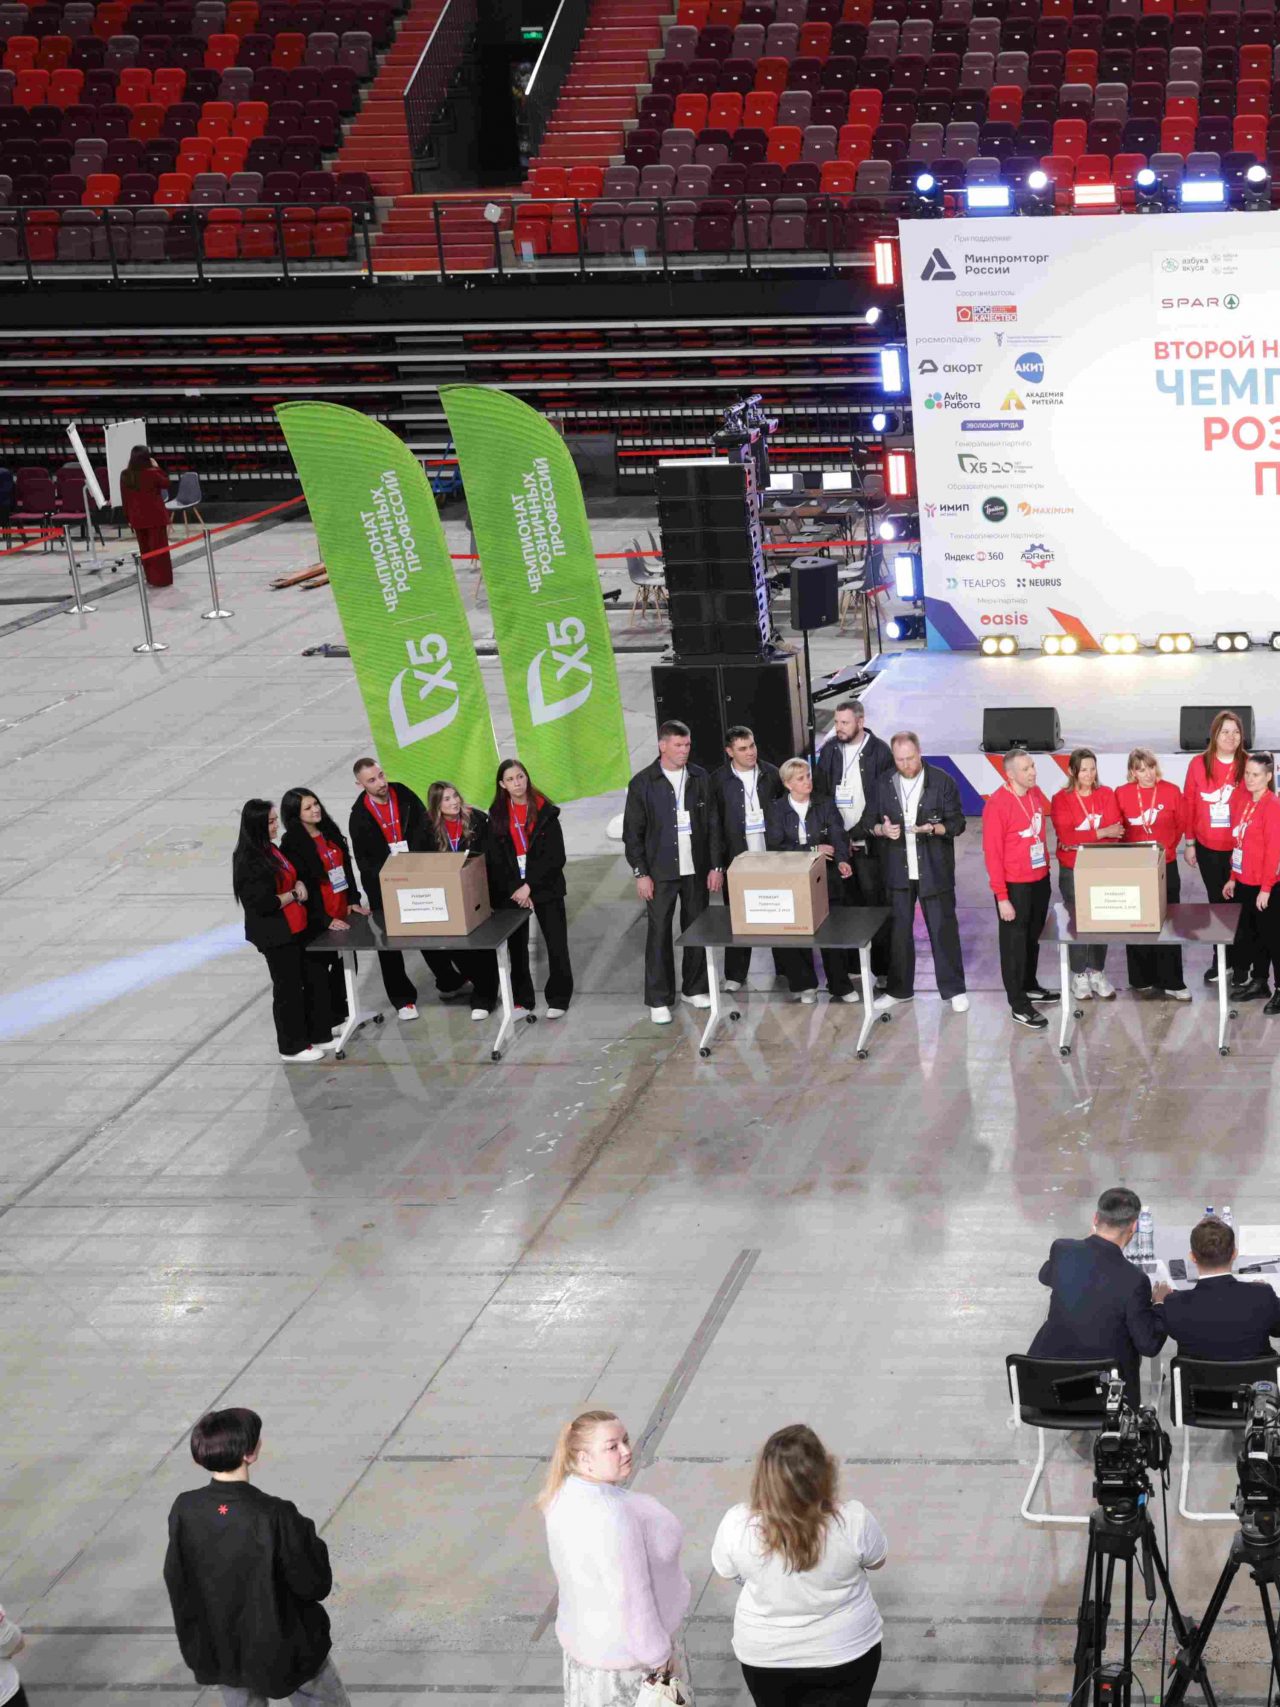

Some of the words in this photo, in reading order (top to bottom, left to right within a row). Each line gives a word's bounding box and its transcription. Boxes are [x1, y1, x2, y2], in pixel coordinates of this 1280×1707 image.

[964, 254, 1050, 264] Минпромторг
[965, 265, 1010, 275] России
[1161, 297, 1220, 309] SPAR
[1154, 335, 1255, 360] ВТОРОЙ
[943, 364, 983, 374] акорт
[1015, 363, 1044, 372] АКИТ
[944, 392, 968, 400] Avito
[944, 400, 981, 409] Работа
[532, 457, 567, 556] ПРОФЕССИЙ
[939, 504, 970, 512] ИМИП
[380, 470, 422, 573] ПРОФЕССИЙ
[522, 471, 555, 575] РОЗНИЧНЫХ
[370, 486, 411, 593] РОЗНИЧНЫХ
[511, 493, 542, 594] ЧЕМПИОНАТ
[944, 553, 975, 561] Яндекс
[987, 552, 1004, 561] 360
[360, 511, 399, 613] ЧЕМПИОНАТ
[962, 578, 1006, 588] TEALPOS
[1029, 579, 1062, 587] NEURUS
[980, 610, 1029, 625] oasis
